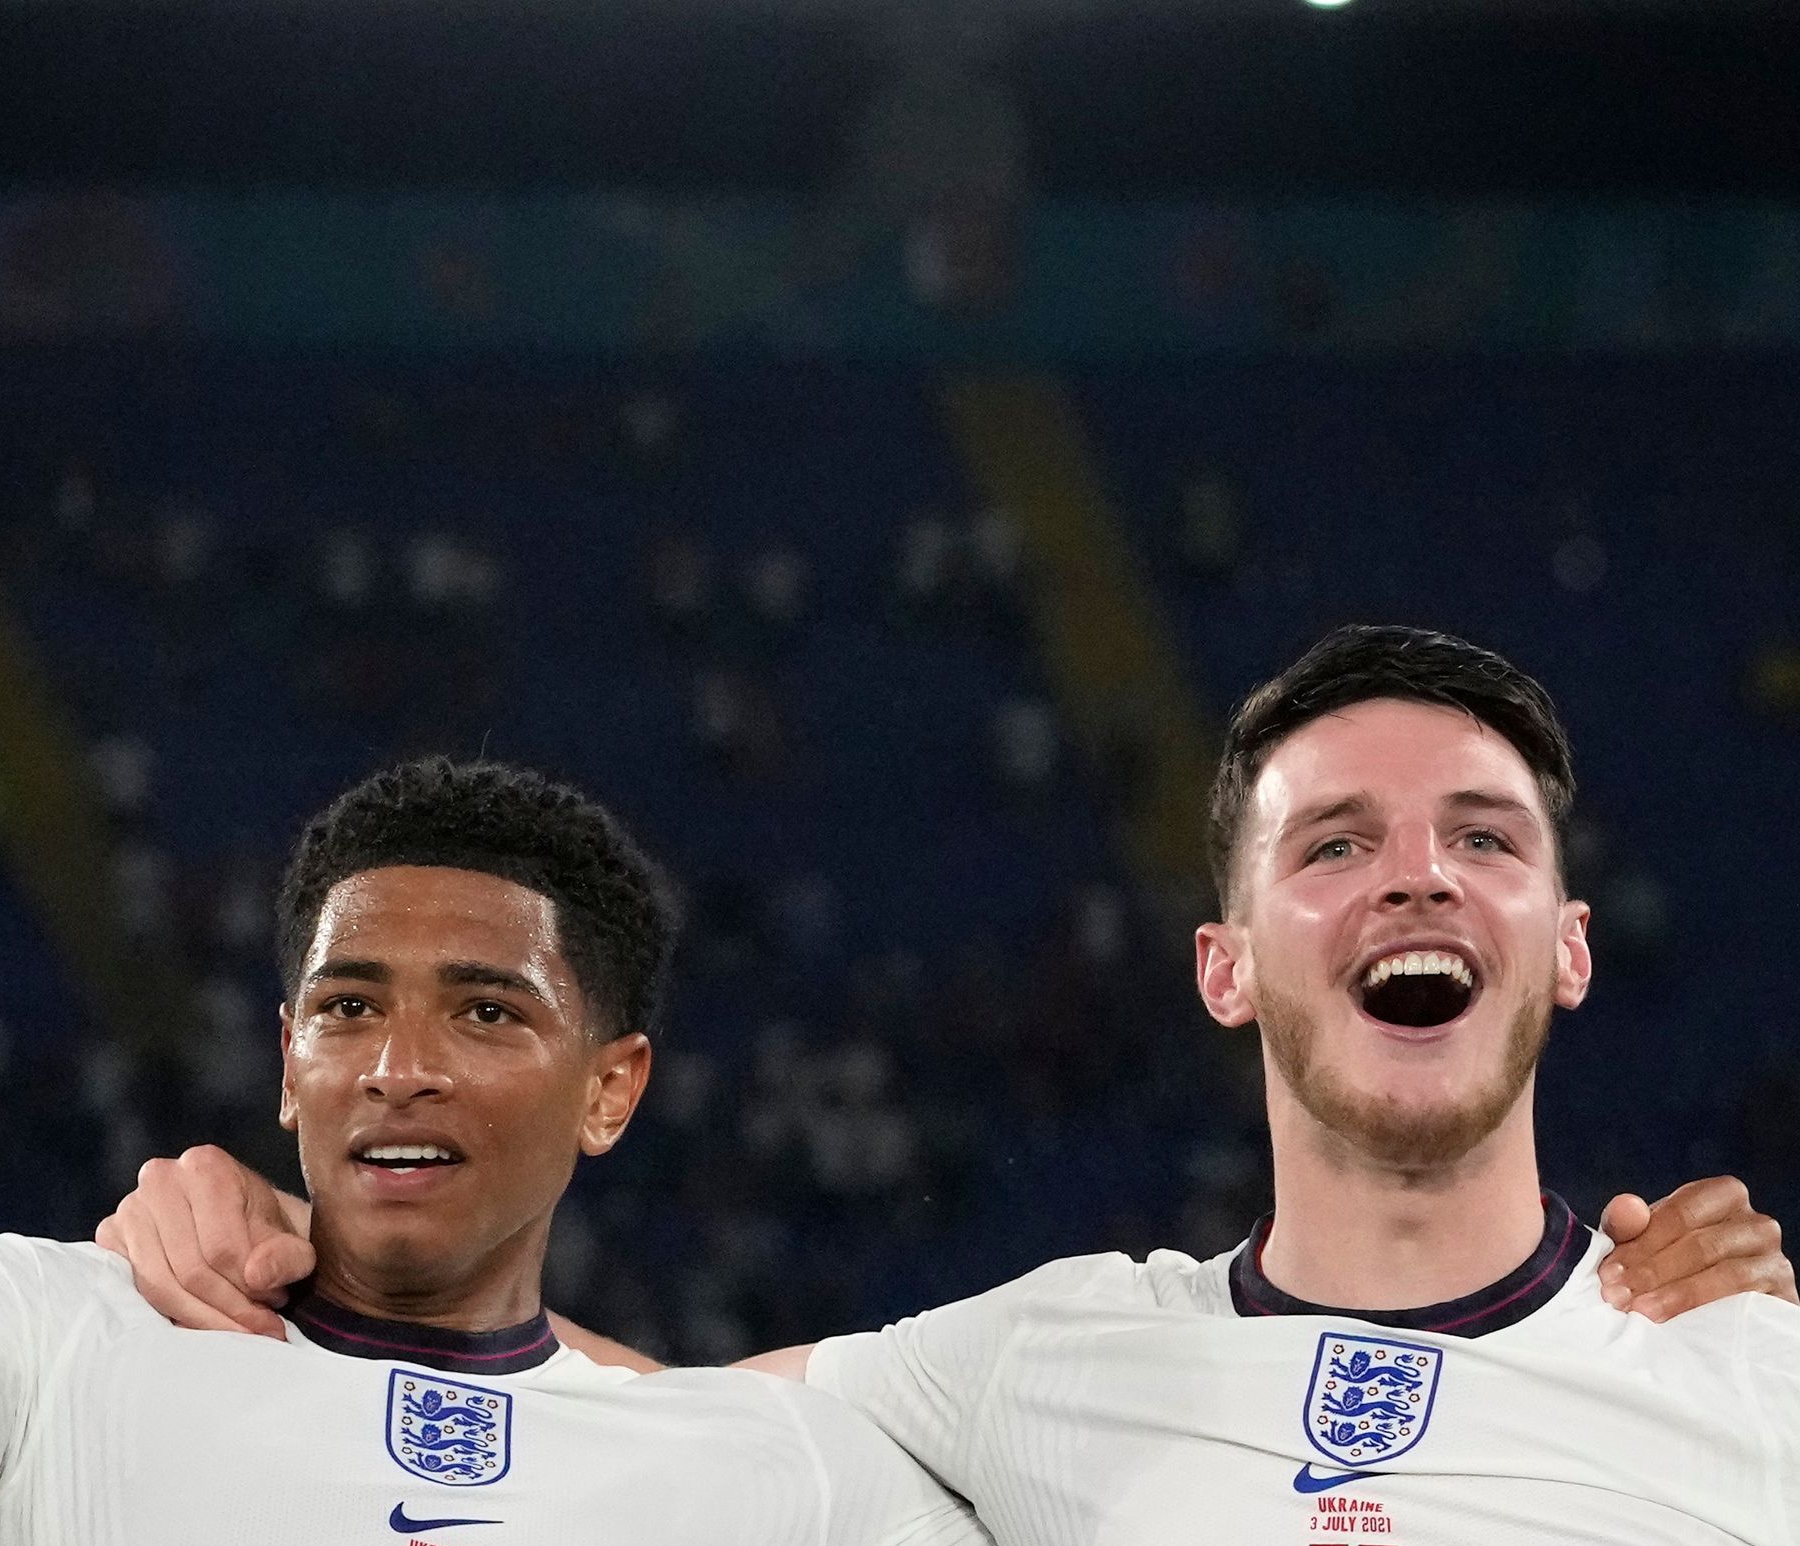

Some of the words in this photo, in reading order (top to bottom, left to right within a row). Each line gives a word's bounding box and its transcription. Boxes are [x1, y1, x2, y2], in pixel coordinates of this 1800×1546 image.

[1318, 1496, 1384, 1513] UKRAINE
[1310, 1516, 1318, 1530] 3
[1322, 1516, 1357, 1532] JULY
[1361, 1516, 1392, 1533] 2021
